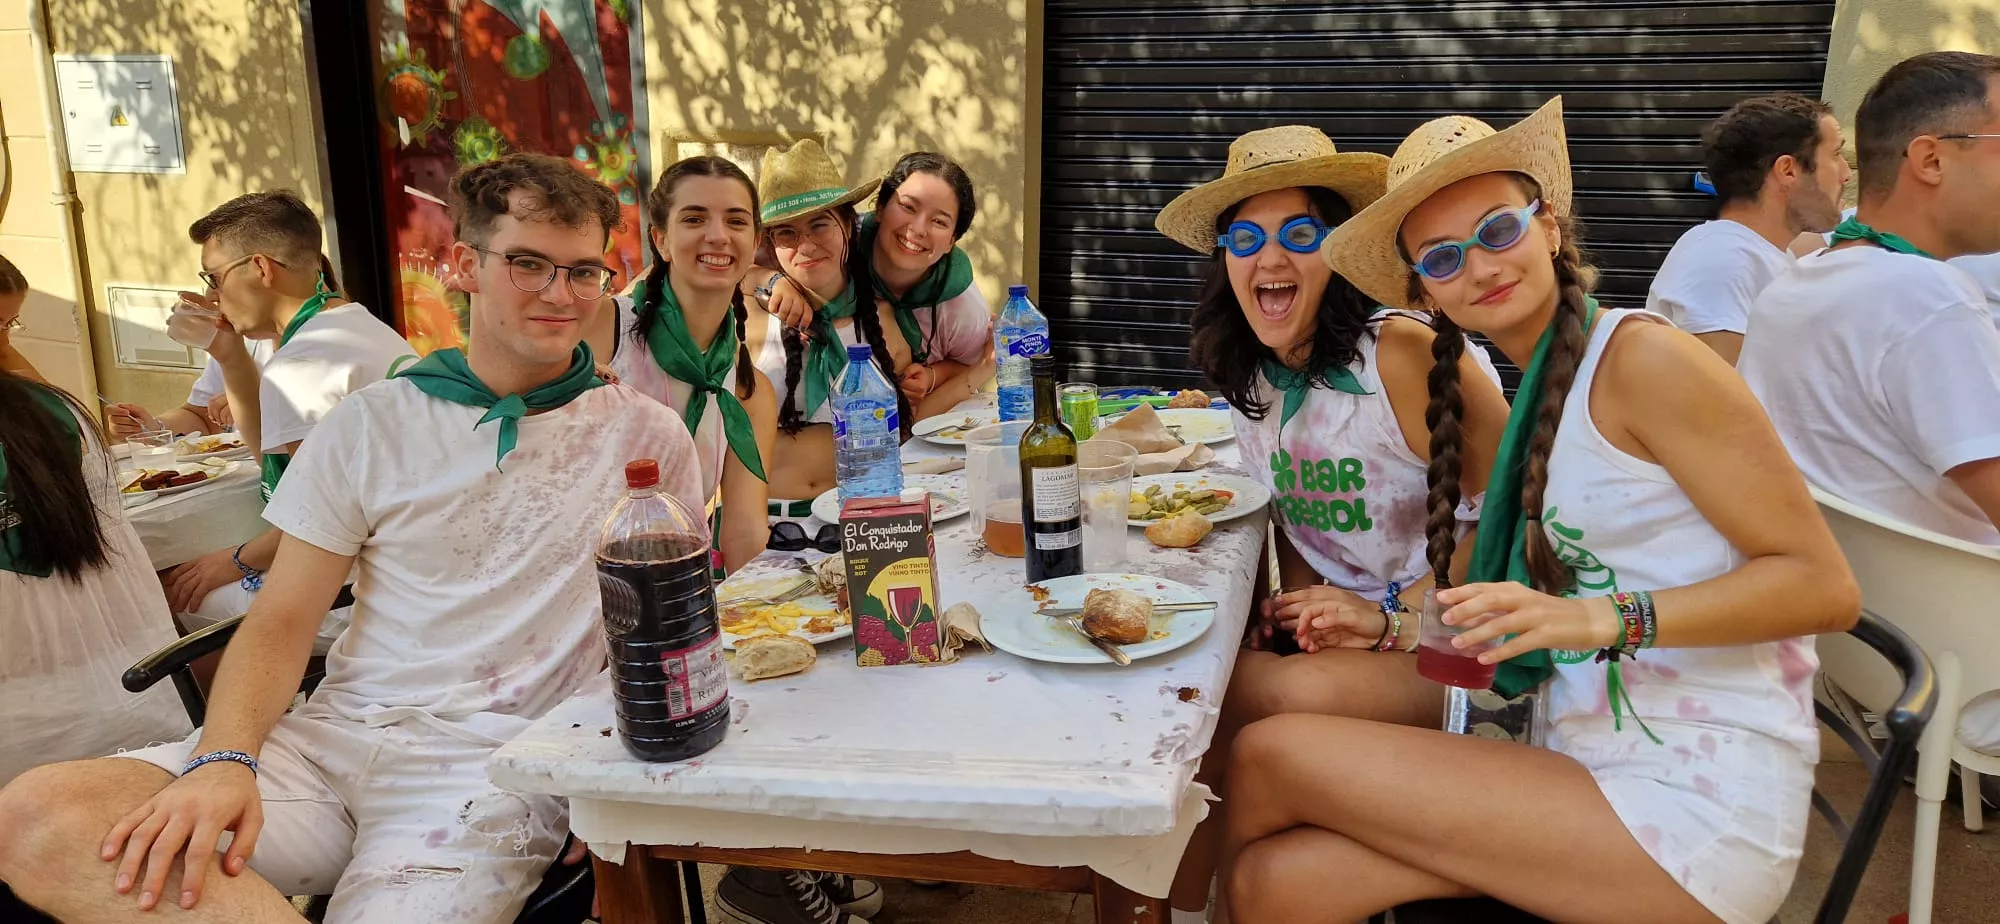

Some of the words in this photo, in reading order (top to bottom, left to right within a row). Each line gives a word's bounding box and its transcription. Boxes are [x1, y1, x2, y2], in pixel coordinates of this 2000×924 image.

[844, 522, 858, 538] El
[859, 519, 923, 539] Conquistador
[844, 537, 868, 552] Don
[868, 536, 909, 553] Rodrigo
